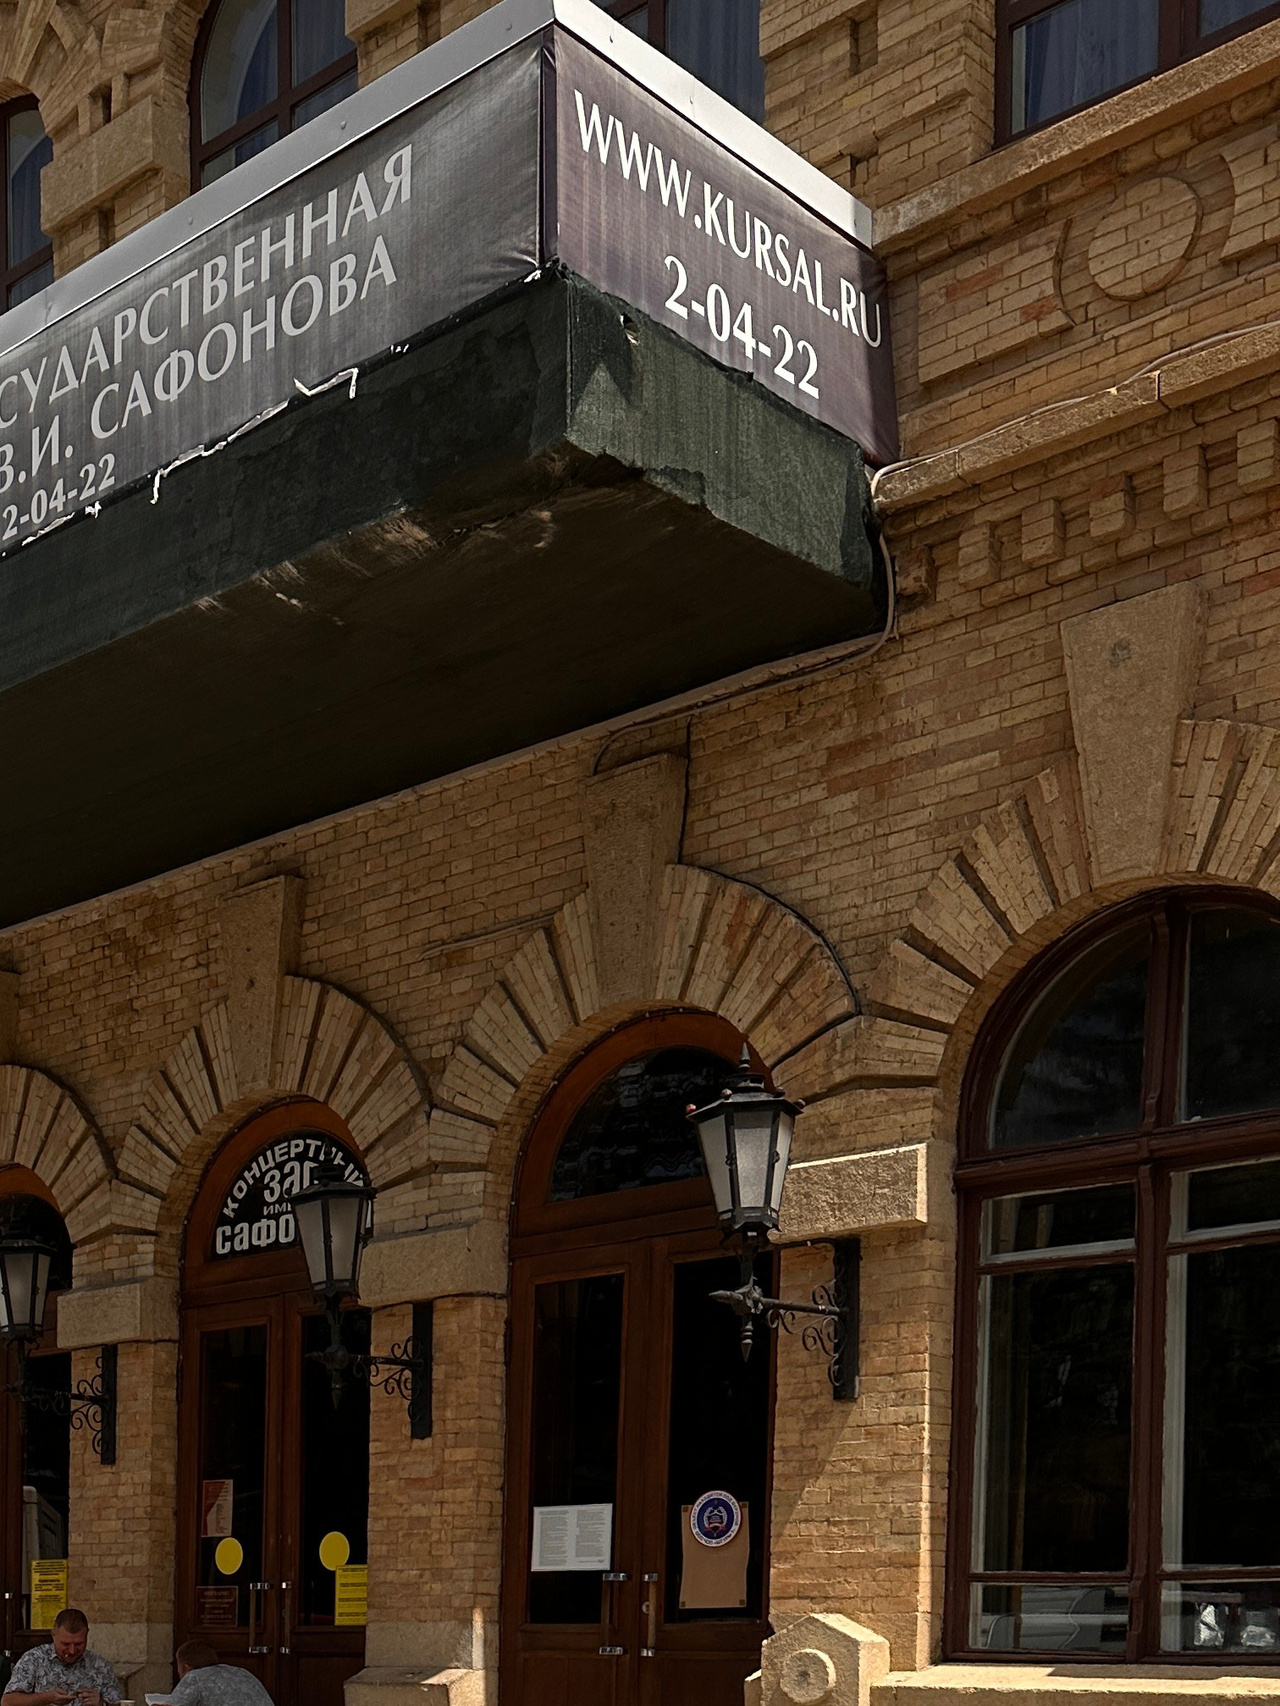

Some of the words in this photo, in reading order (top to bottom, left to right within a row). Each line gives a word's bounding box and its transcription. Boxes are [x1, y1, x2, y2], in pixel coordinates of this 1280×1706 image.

[574, 88, 881, 348] WWW.KURSAL.RU
[91, 235, 397, 439] САФОНОВА
[664, 255, 819, 399] 2-04-22
[2, 453, 115, 540] 2-04-22
